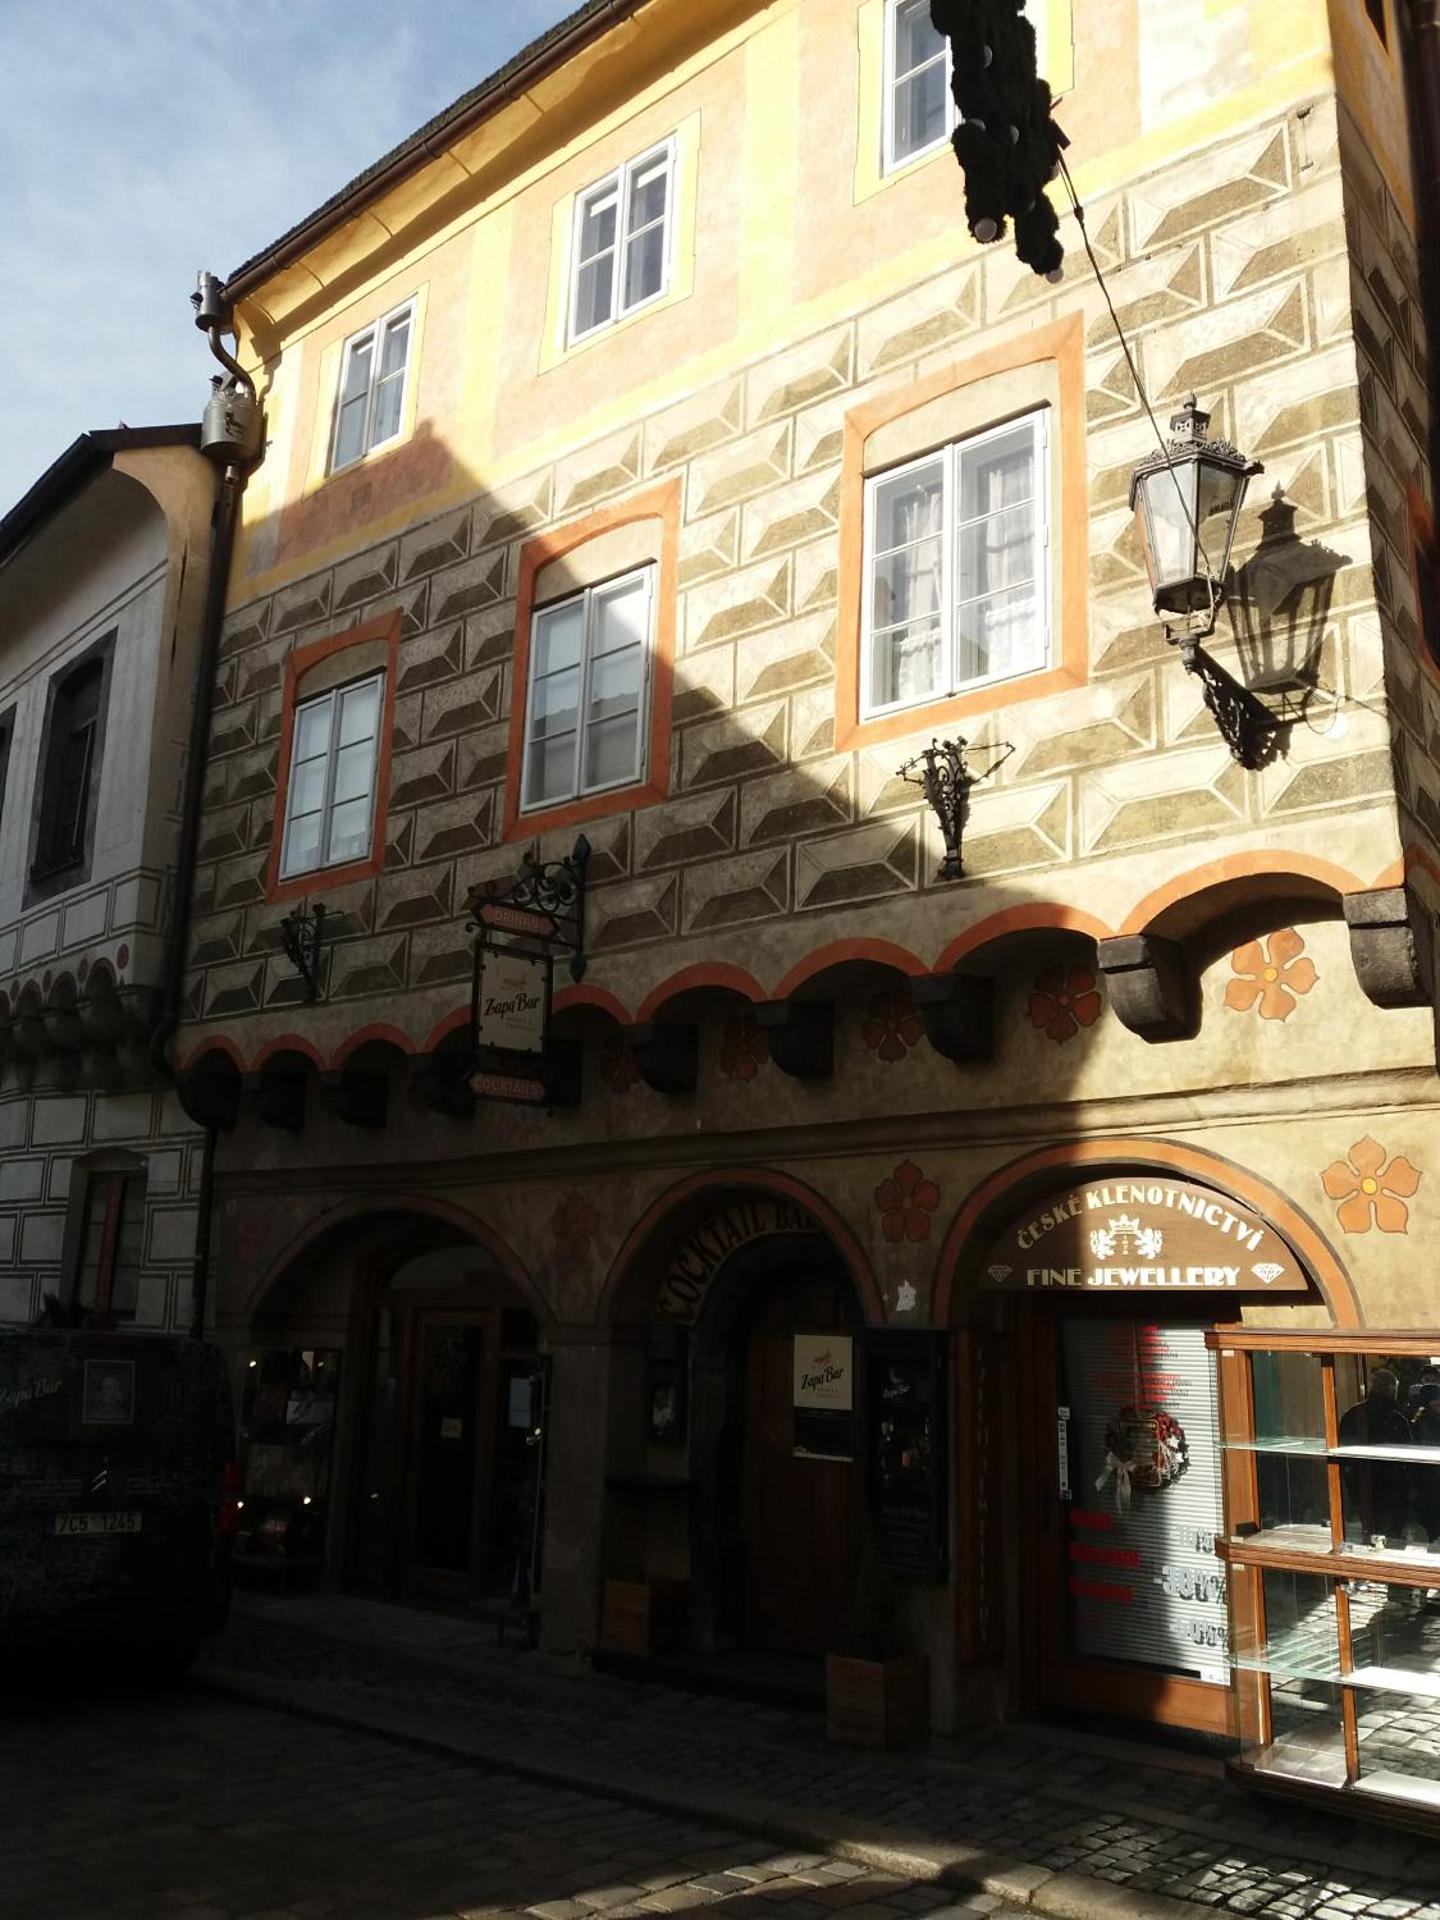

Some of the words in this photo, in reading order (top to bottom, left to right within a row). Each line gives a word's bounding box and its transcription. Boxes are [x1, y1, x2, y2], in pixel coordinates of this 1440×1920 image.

[515, 992, 541, 1011] Bar
[656, 1202, 766, 1320] COCKTAIL
[1027, 1269, 1082, 1286] FINE
[1088, 1267, 1241, 1287] JEWELLERY
[824, 1366, 844, 1383] Bar
